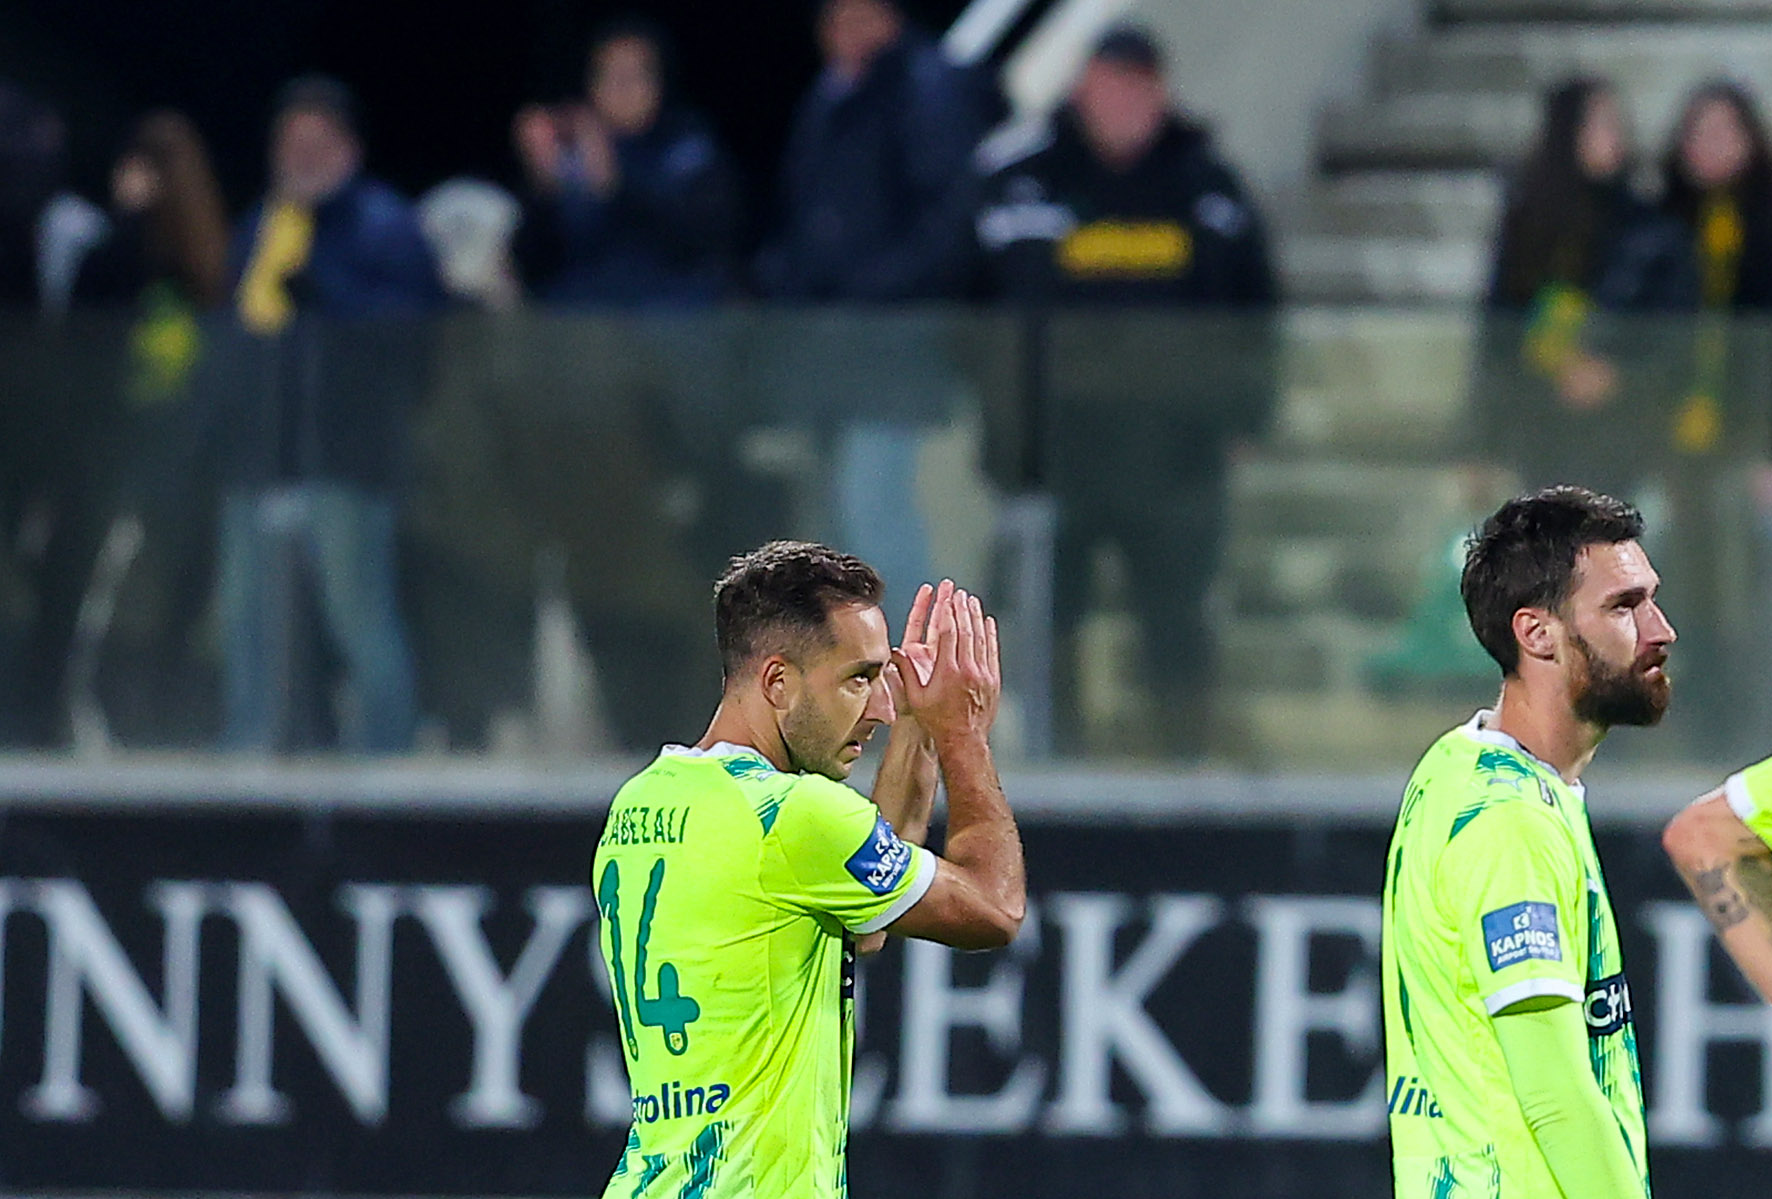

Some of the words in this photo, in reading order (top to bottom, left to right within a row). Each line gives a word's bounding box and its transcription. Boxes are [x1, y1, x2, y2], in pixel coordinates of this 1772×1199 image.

[867, 832, 905, 887] KAPN
[599, 858, 701, 1062] 14
[1491, 929, 1556, 957] KAPNOS
